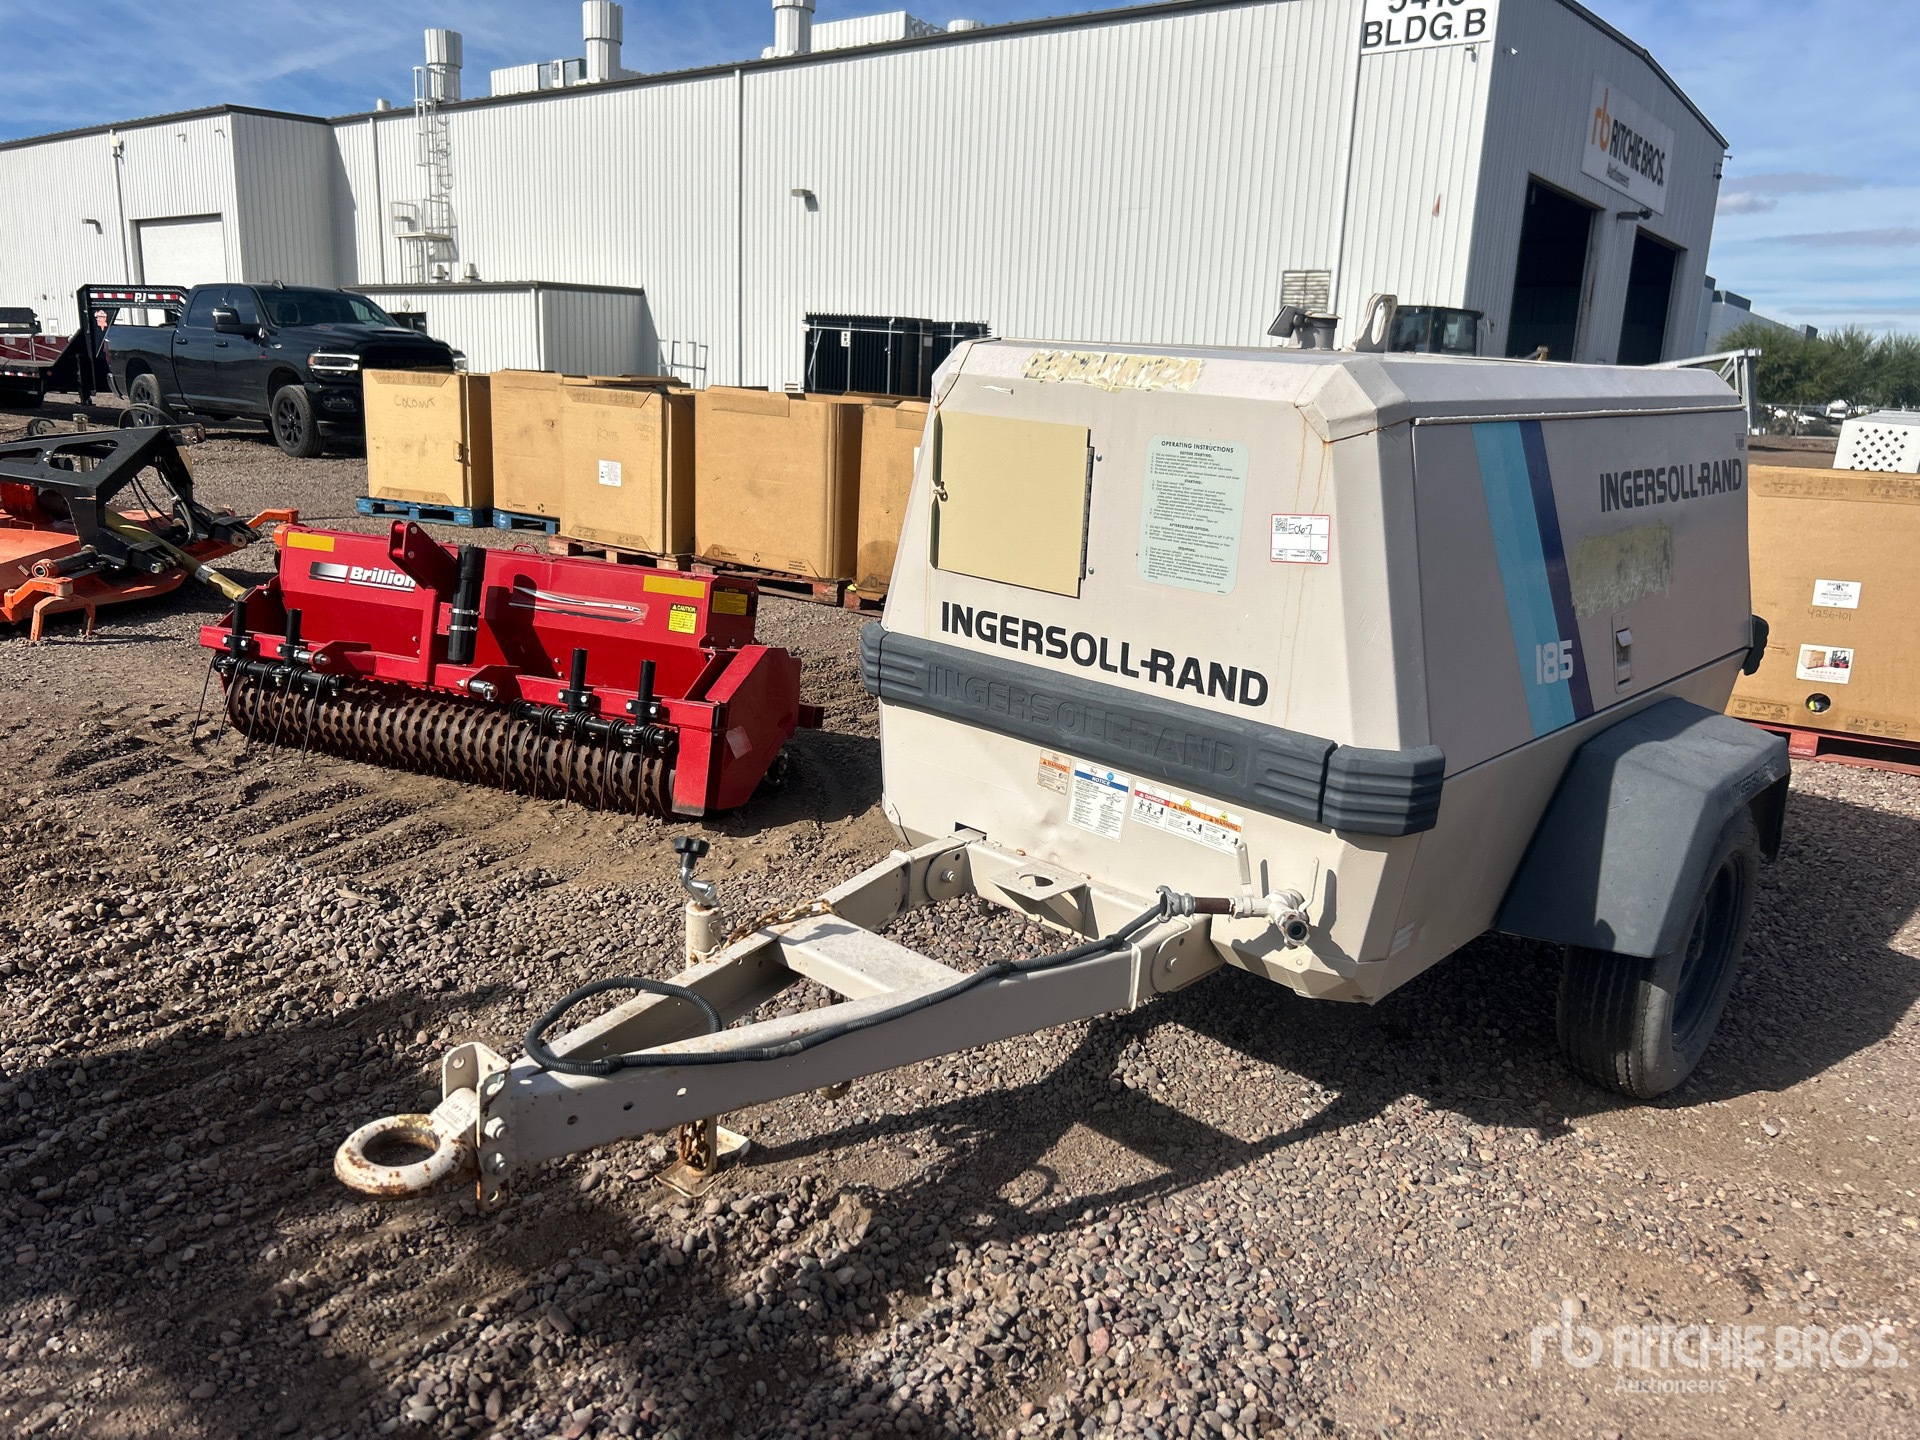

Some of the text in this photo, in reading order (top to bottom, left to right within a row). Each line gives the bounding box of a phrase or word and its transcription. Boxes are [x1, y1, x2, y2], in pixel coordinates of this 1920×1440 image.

[1463, 8, 1487, 37] B
[1609, 119, 1643, 172] RITCHIE
[1640, 139, 1665, 187] BROS.
[134, 292, 147, 303] PJ
[1160, 440, 1234, 453] OPERATING INSTRUCTIONS
[1599, 458, 1742, 512] INGERSOLL-RAND
[349, 566, 416, 588] Brillion
[677, 605, 696, 613] CAUTION
[1807, 608, 1852, 621] 4256-101
[941, 601, 1269, 707] INGERSOLL-RAND
[1535, 639, 1574, 685] 185
[1046, 760, 1067, 772] WARNING
[1091, 776, 1111, 786] NOTICE
[1144, 793, 1238, 831] DANGER WARNING WARNING
